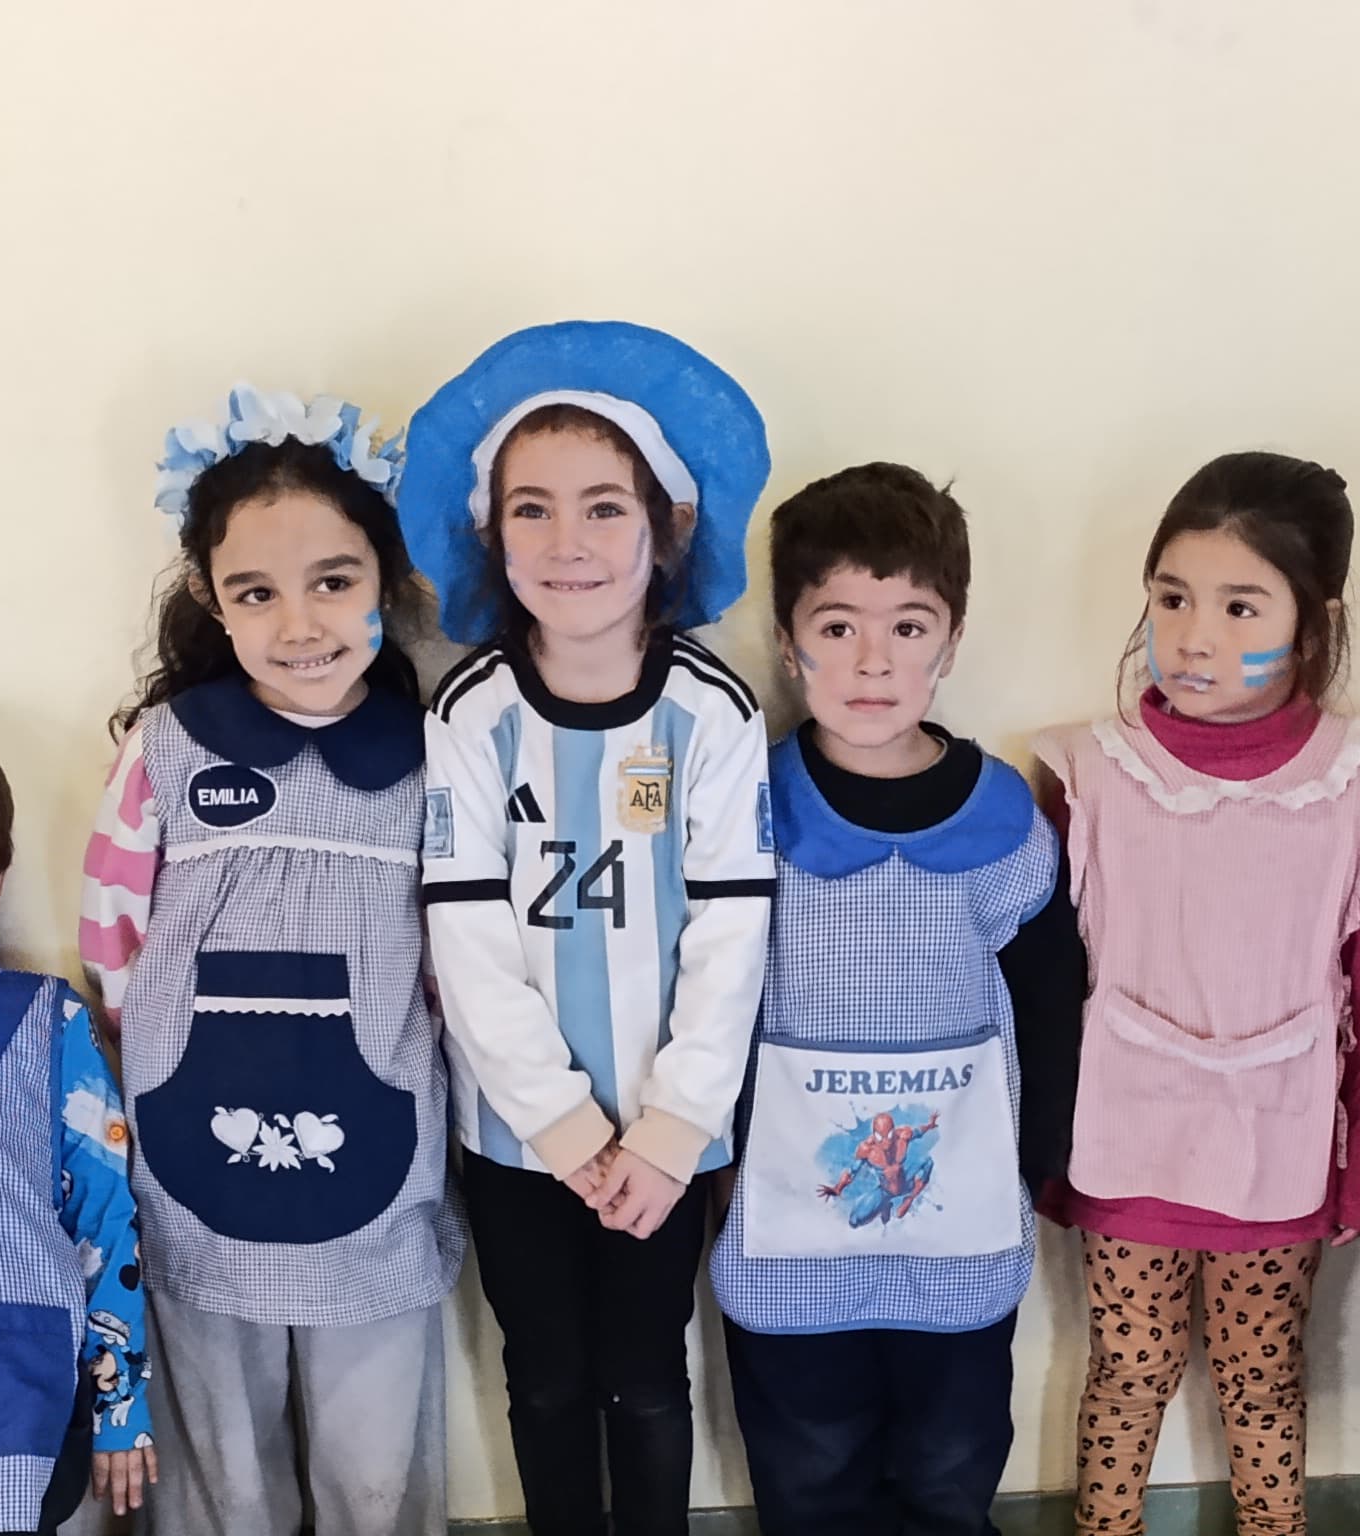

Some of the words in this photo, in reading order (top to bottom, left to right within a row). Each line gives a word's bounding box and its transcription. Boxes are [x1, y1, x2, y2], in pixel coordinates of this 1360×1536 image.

[197, 788, 259, 806] EMILIA
[630, 780, 663, 812] AFA
[527, 840, 625, 929] 24
[805, 1063, 974, 1095] JEREMIAS
